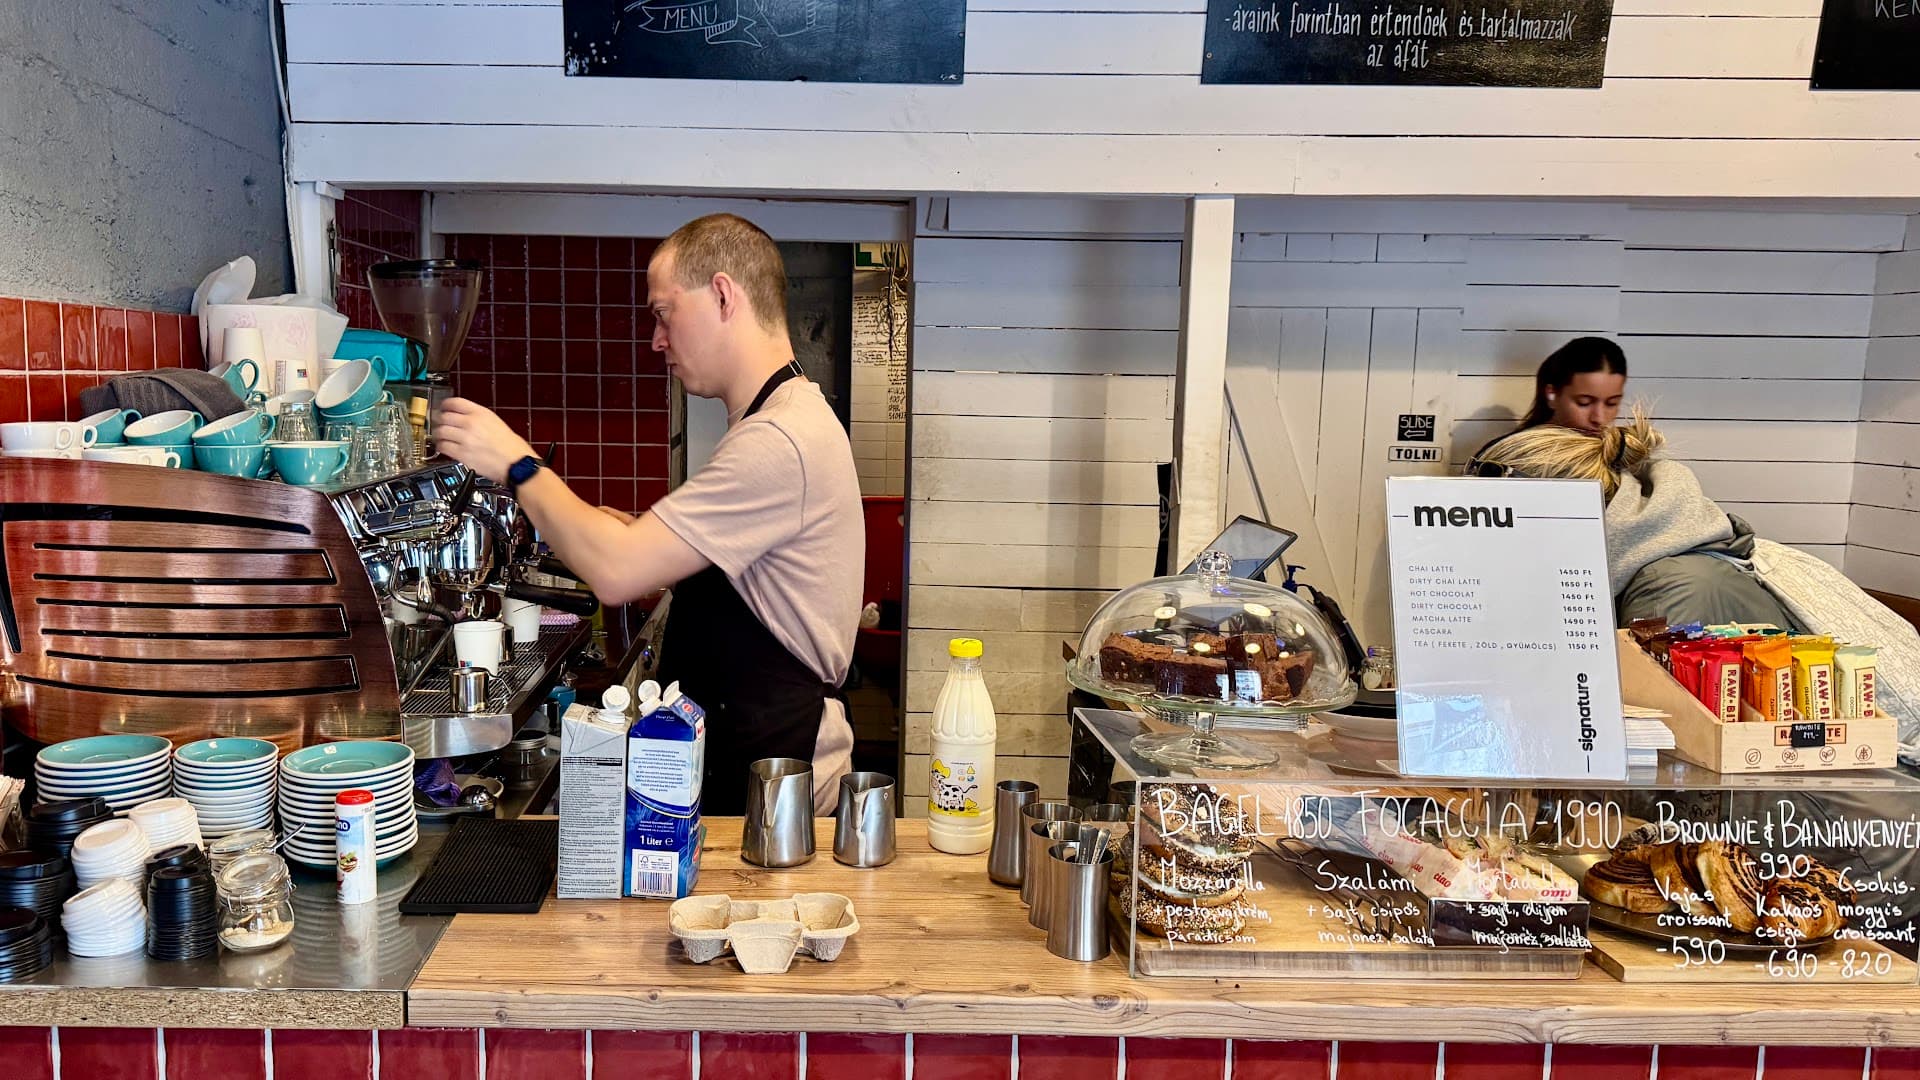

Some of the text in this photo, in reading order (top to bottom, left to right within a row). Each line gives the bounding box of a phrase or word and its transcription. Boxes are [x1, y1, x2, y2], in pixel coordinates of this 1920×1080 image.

[664, 4, 717, 30] MENU
[1290, 1, 1361, 38] forintban
[1458, 10, 1473, 38] és
[1480, 7, 1578, 41] tartalmazzák
[1367, 44, 1384, 67] az
[1393, 39, 1430, 71] áfát
[1400, 416, 1433, 429] SLIDE
[1395, 448, 1436, 460] TOLNI
[1414, 505, 1514, 528] menu
[1429, 590, 1474, 598] CHOCOLAT
[1476, 641, 1497, 649] ZÖLD
[1577, 672, 1597, 751] signature
[640, 835, 663, 846] 1 Liter
[1161, 854, 1265, 891] Mozzarella
[1314, 859, 1418, 893] Szalámi
[1433, 871, 1452, 888] ciao
[1540, 889, 1571, 901] ciao
[1654, 876, 1715, 913] Vajas
[1306, 904, 1316, 917] +
[1323, 899, 1364, 925] sajt,
[1756, 893, 1822, 920] Kakaós
[1838, 903, 1902, 928] mogyis
[1656, 910, 1733, 928] croissant
[1167, 929, 1256, 951] paradicsom
[1393, 925, 1435, 948] saláta
[1755, 923, 1807, 949] csiga
[1833, 921, 1917, 943] croissant
